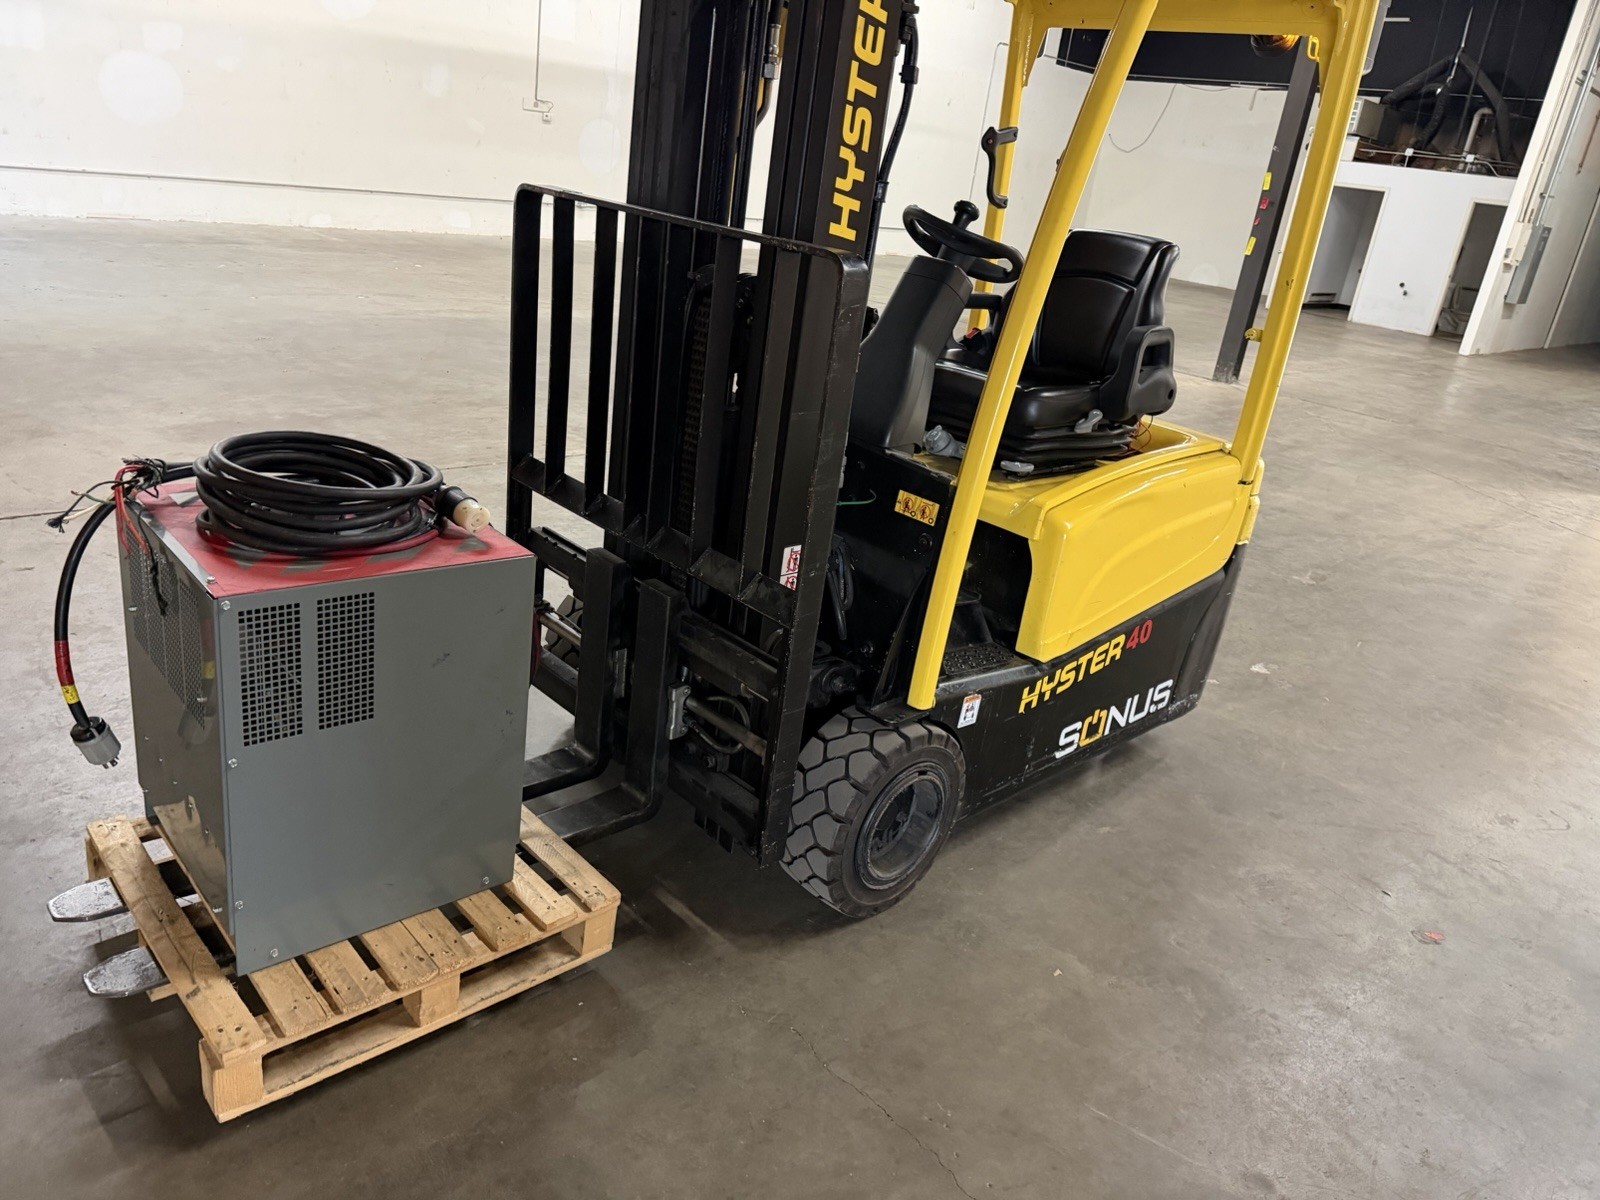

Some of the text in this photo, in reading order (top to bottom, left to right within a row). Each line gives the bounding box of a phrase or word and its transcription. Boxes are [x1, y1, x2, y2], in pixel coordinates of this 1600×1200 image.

[1018, 619, 1153, 714] HYSTER 40
[1055, 679, 1174, 759] SONUS
